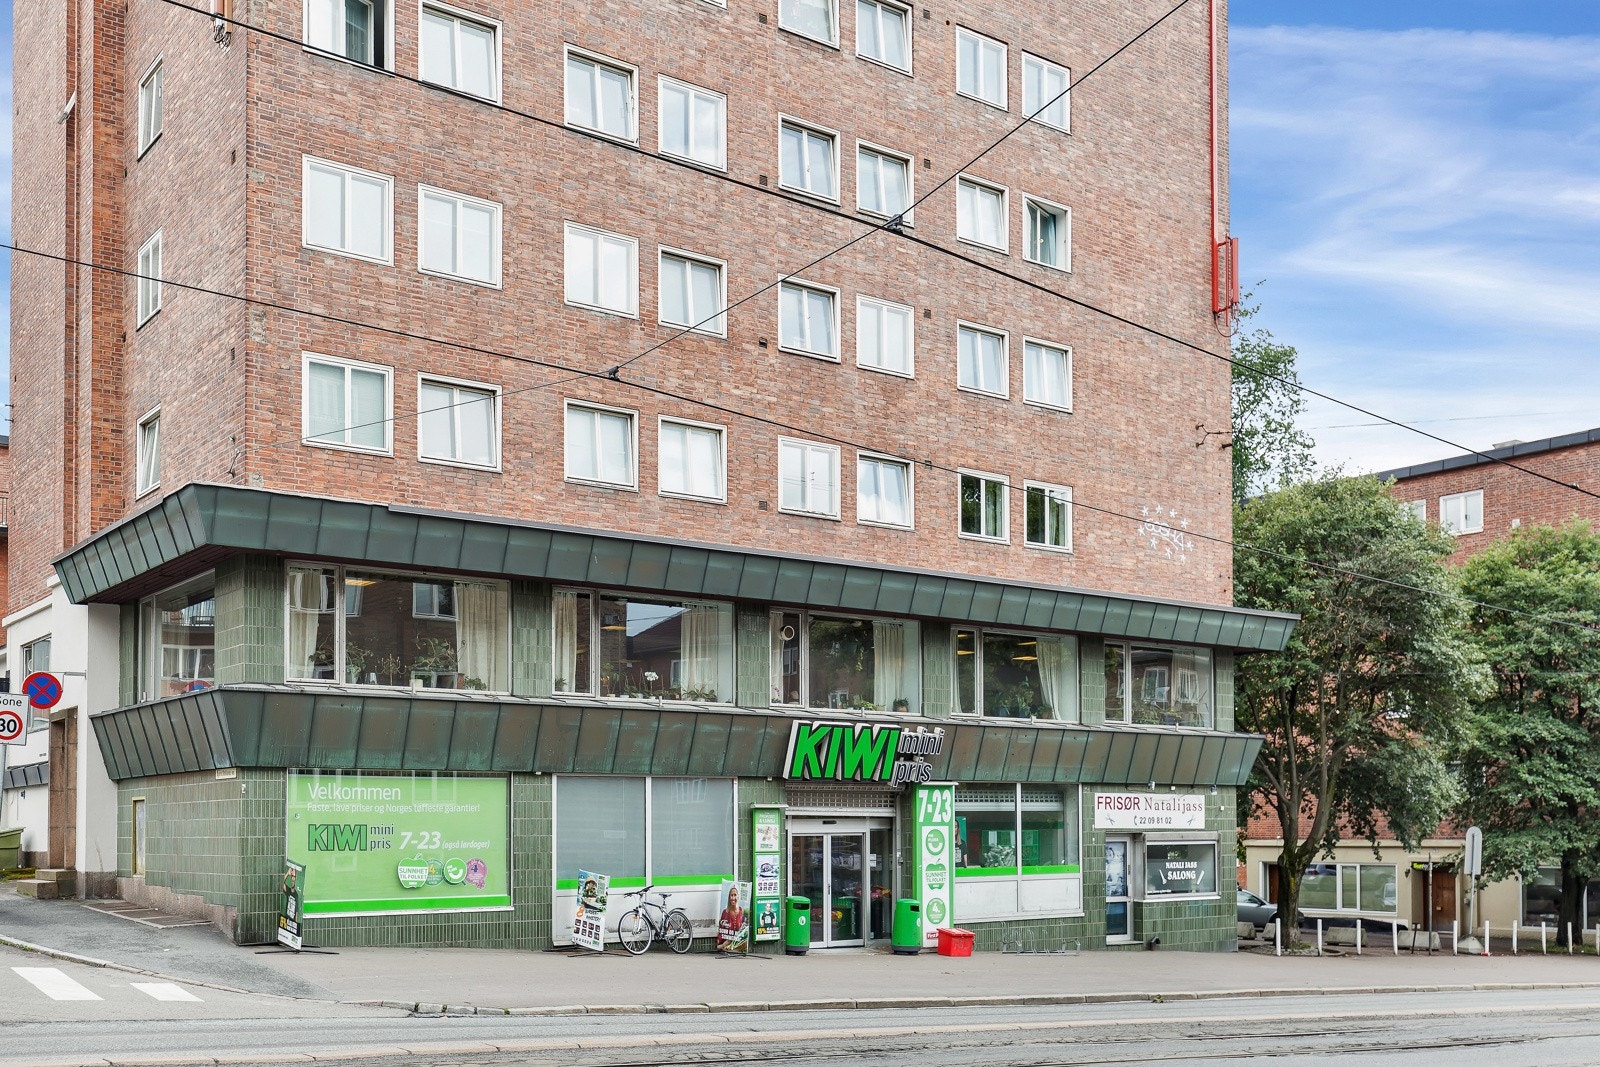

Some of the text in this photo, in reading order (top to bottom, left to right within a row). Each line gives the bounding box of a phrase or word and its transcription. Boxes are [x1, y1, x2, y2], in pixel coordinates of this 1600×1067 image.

[0, 696, 22, 706] one
[899, 727, 945, 755] mini
[785, 721, 902, 781] KIWI
[891, 756, 932, 787] pris
[307, 782, 401, 801] Velkommen
[307, 802, 332, 813] Faste,
[333, 803, 350, 812] lave
[351, 804, 373, 814] priser
[374, 805, 385, 814] og
[386, 804, 413, 814] Norges
[445, 804, 480, 814] garantier!
[918, 789, 952, 823] 7-23
[1097, 795, 1141, 811] FRISØR
[370, 823, 394, 835] mini
[1139, 816, 1147, 825] 22
[1147, 816, 1156, 825] 09
[1165, 816, 1172, 825] 02
[308, 824, 368, 851] KIWI
[370, 837, 391, 851] pris
[399, 831, 441, 850] 7-23
[1167, 870, 1196, 880] SALONG
